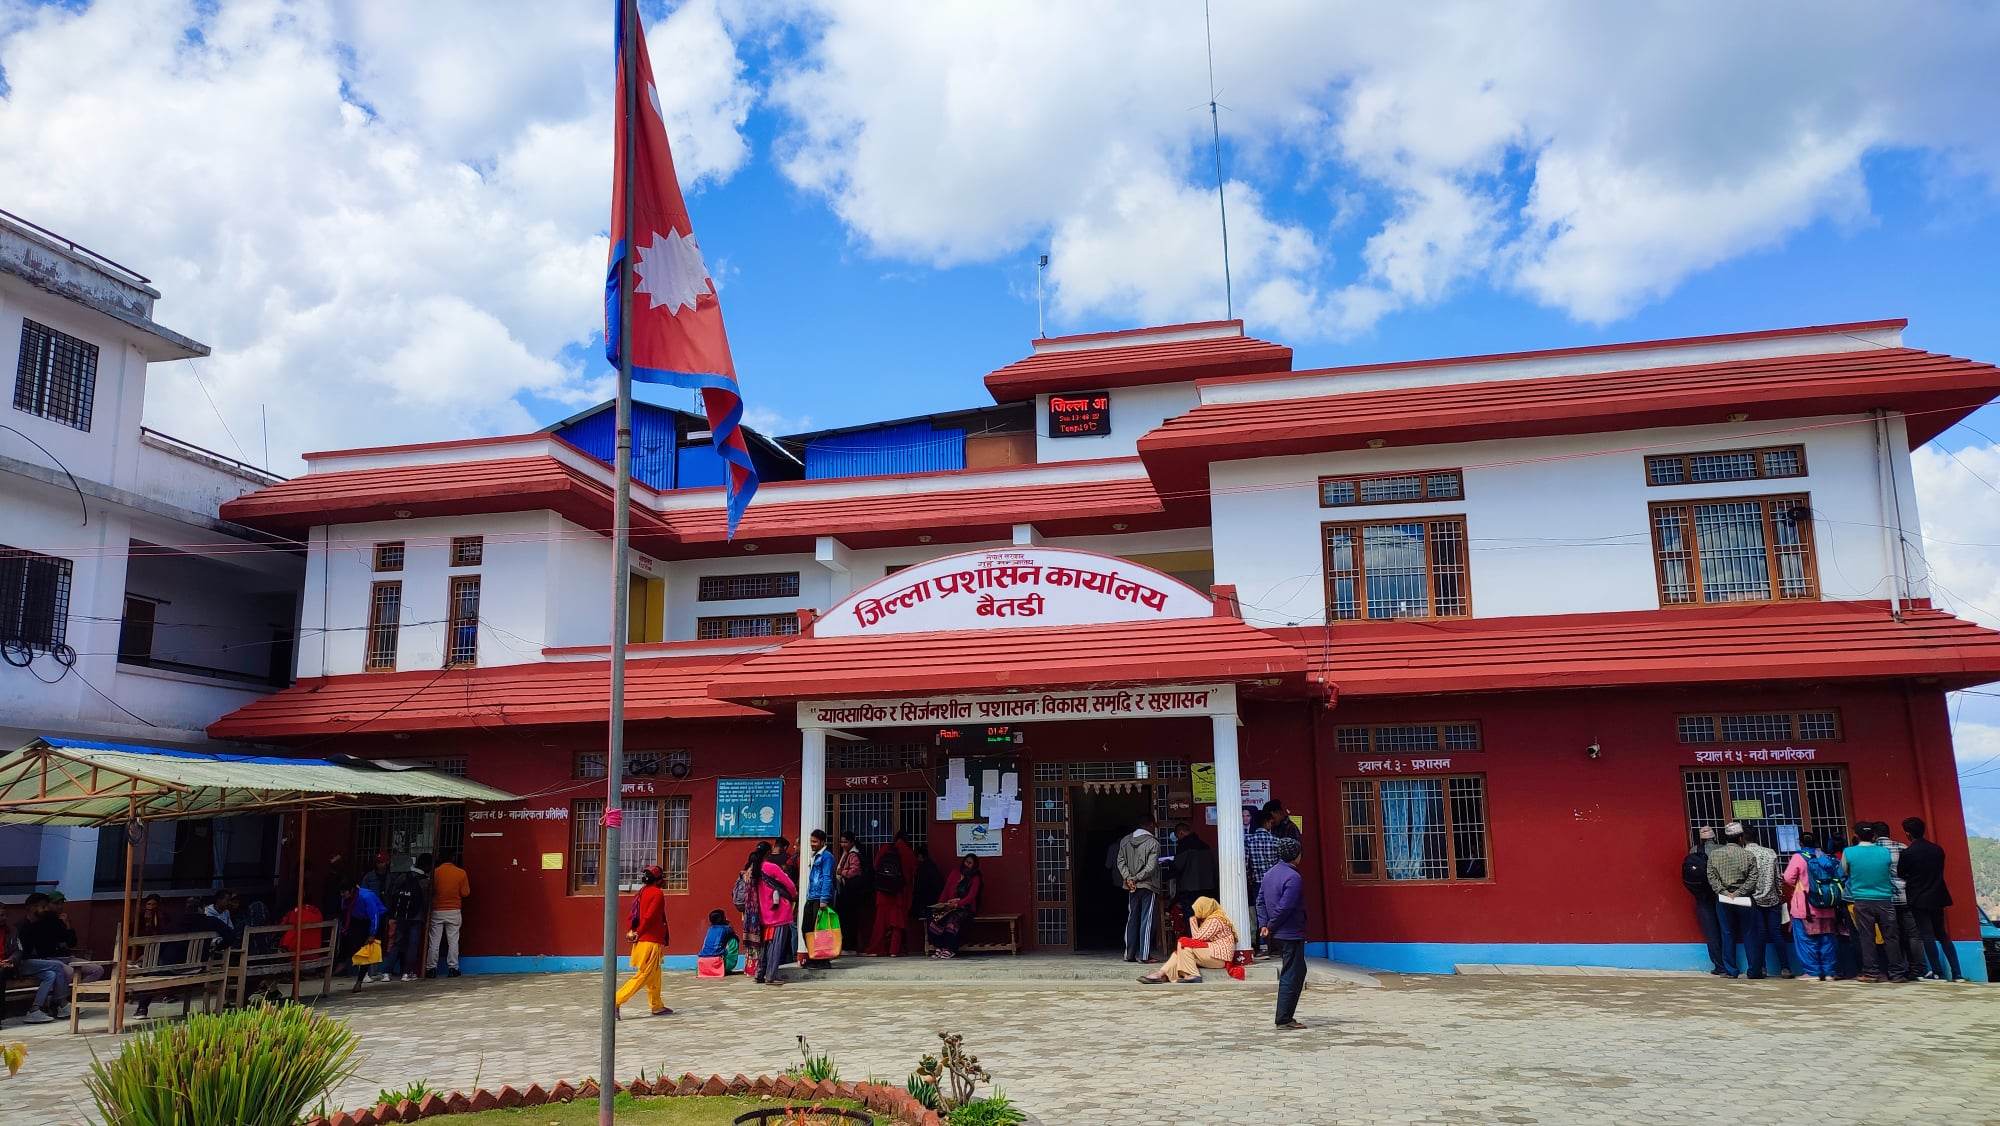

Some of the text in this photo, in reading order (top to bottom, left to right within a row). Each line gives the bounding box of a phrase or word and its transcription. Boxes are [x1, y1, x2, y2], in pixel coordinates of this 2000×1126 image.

[1051, 397, 1089, 413] जिल्ला
[852, 566, 1169, 628] जिल्ला प्रशासन कार्यालय
[976, 592, 1045, 617] बैतडी
[890, 705, 898, 721] र
[900, 699, 973, 721] सिर्जनशील
[1135, 693, 1145, 710] र
[1770, 746, 1816, 761] नागरिकता
[1411, 758, 1451, 770] प्रशासन
[508, 807, 544, 820] नागरिकता
[545, 806, 569, 820] प्रतिलिपि
